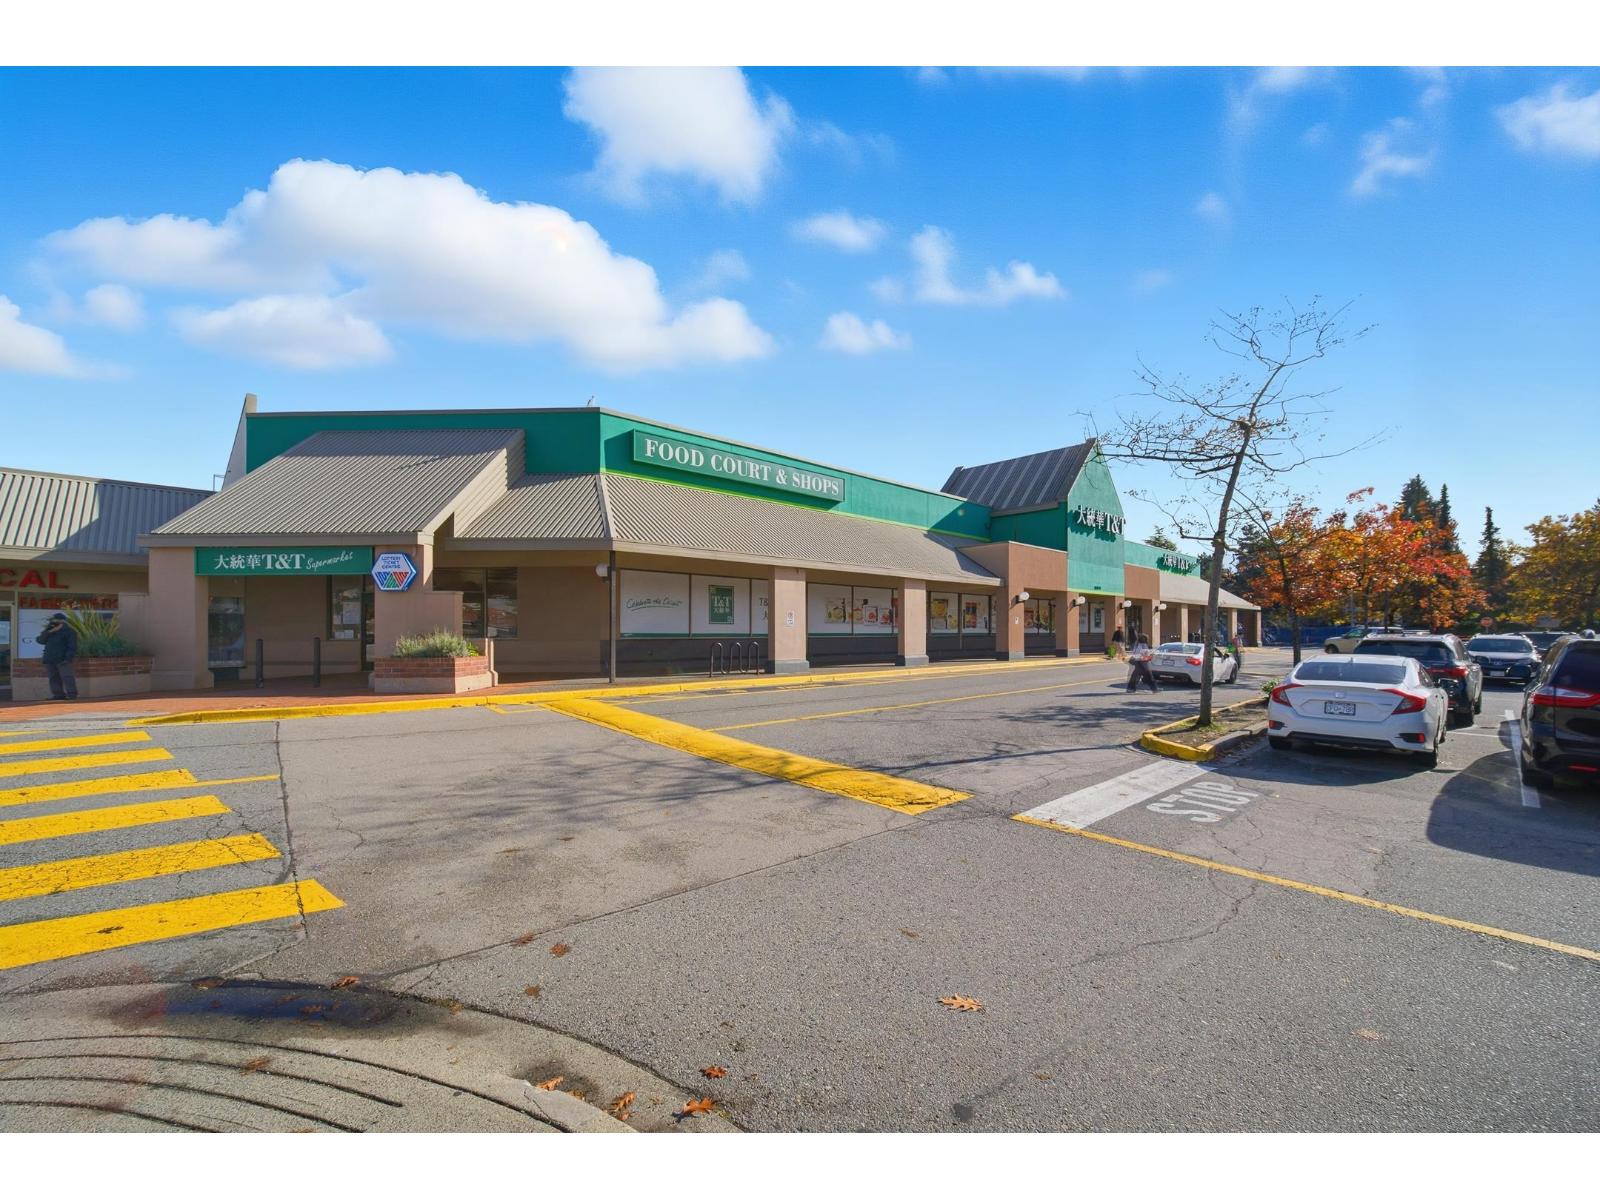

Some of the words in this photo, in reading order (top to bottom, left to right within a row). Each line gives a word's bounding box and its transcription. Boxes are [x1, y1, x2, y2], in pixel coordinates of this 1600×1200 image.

[645, 438, 704, 468] FOOD
[711, 454, 771, 481] COURT
[776, 469, 787, 485] &
[792, 473, 839, 495] SHOPS
[306, 550, 353, 572] Supermarket
[1146, 781, 1259, 822] STOP
